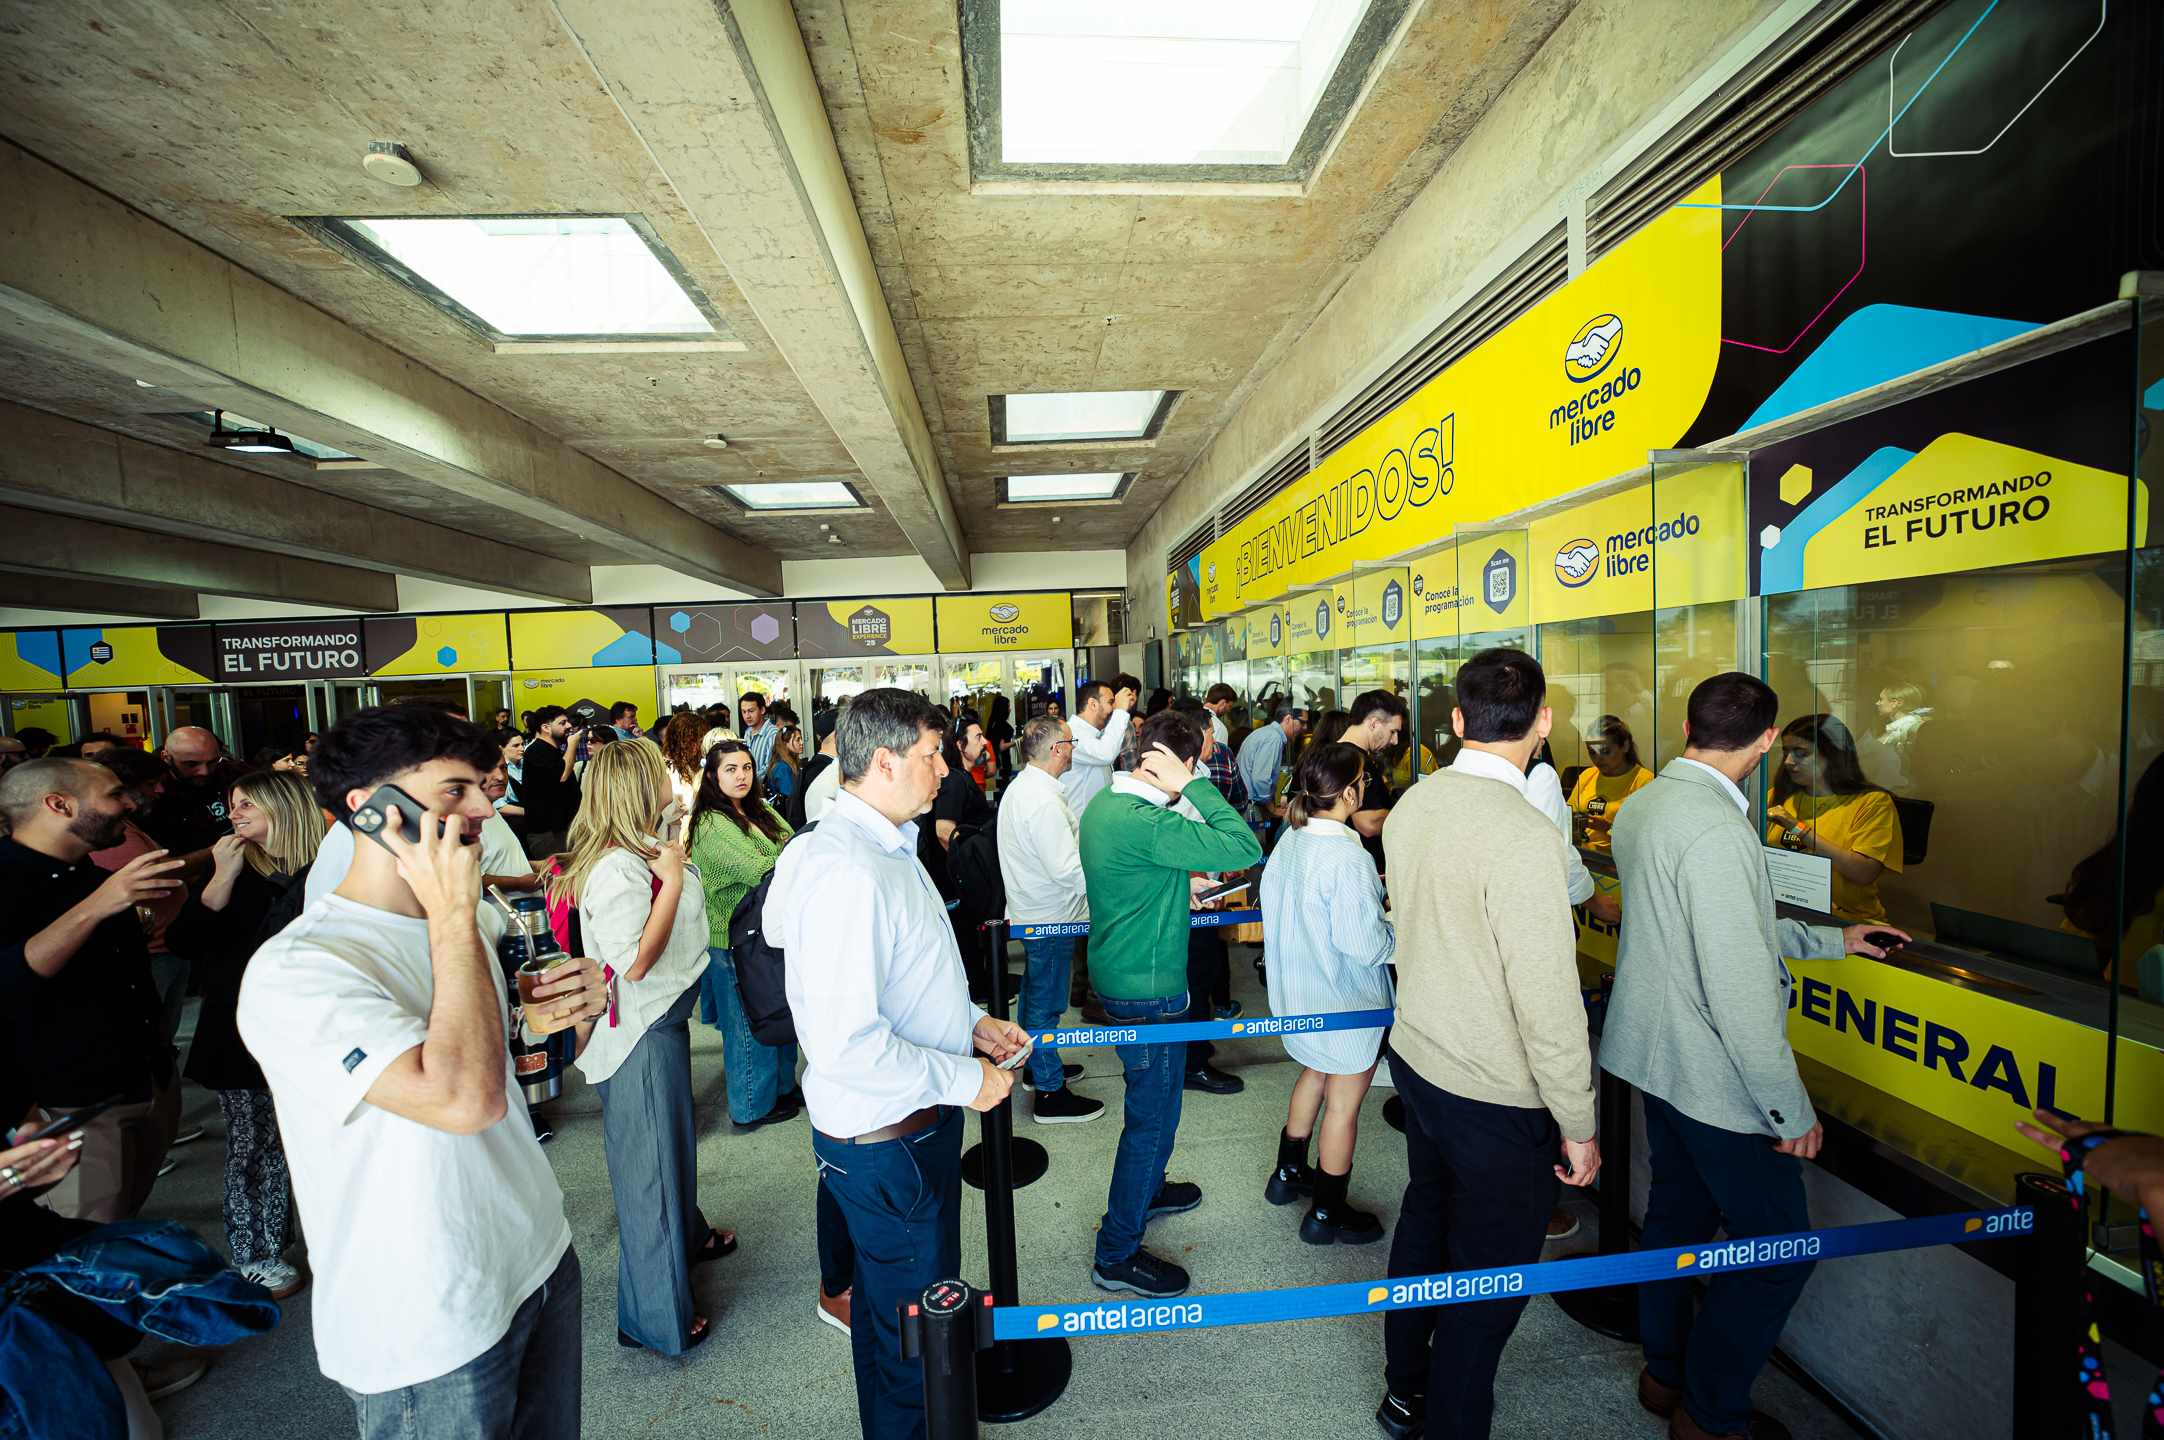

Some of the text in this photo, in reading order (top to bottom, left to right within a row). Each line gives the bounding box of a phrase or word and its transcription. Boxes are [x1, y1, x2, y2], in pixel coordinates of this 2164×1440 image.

[1550, 367, 1641, 429] mercado
[1571, 410, 1615, 446] libre
[1235, 412, 1455, 599] ¡BIENVENIDOS!
[1865, 471, 2052, 521] TRANSFORMANDO
[1606, 512, 1700, 554] mercado
[1864, 495, 2050, 549] EL FUTURO
[1606, 553, 1649, 578] libre
[1425, 587, 1451, 602] Conocé
[1425, 594, 1475, 615] programación
[852, 624, 887, 634] LIBRE
[981, 625, 1029, 635] mercado
[994, 635, 1017, 644] libre
[222, 633, 358, 650] TRANSFORMANDO
[223, 649, 359, 672] EL FUTURO
[256, 687, 297, 695] FUTURO
[1035, 923, 1090, 935] antel arena
[1191, 914, 1219, 926] arena
[1247, 1016, 1324, 1034] antel arena
[1056, 1029, 1137, 1045] antel arena
[1986, 1208, 2033, 1233] ante
[1699, 1236, 1820, 1269] antel arena
[1392, 1273, 1524, 1303] antel arena
[1063, 1303, 1203, 1331] antel arena
